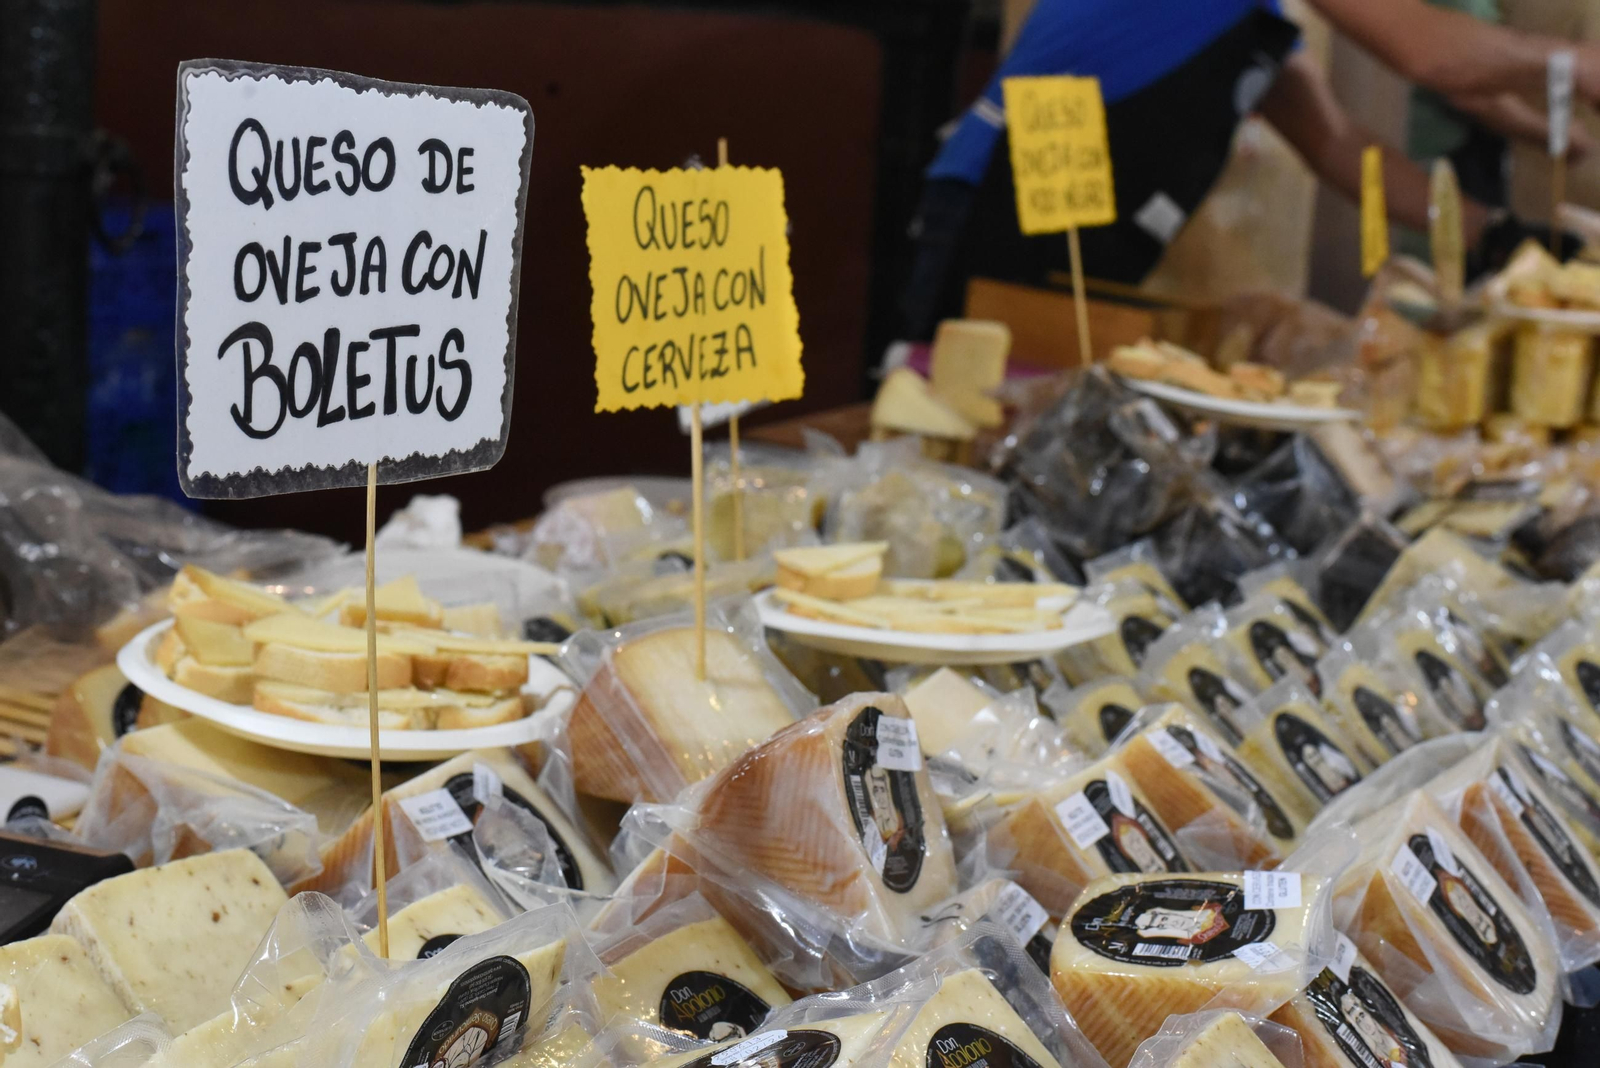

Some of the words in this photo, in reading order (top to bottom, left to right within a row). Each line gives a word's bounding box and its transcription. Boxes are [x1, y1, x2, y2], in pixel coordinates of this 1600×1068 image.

[228, 117, 396, 211] QUESO
[418, 138, 475, 194] DE
[633, 185, 729, 251] QUESO
[234, 232, 387, 305] OVEJA
[401, 229, 488, 300] CON
[616, 266, 706, 324] OVEJA
[713, 246, 766, 312] CON
[217, 321, 472, 439] BOLETUS
[621, 323, 757, 394] CERVEZA
[670, 986, 693, 1004] Don
[670, 985, 726, 1022] Apolonio
[936, 1037, 960, 1054] Don
